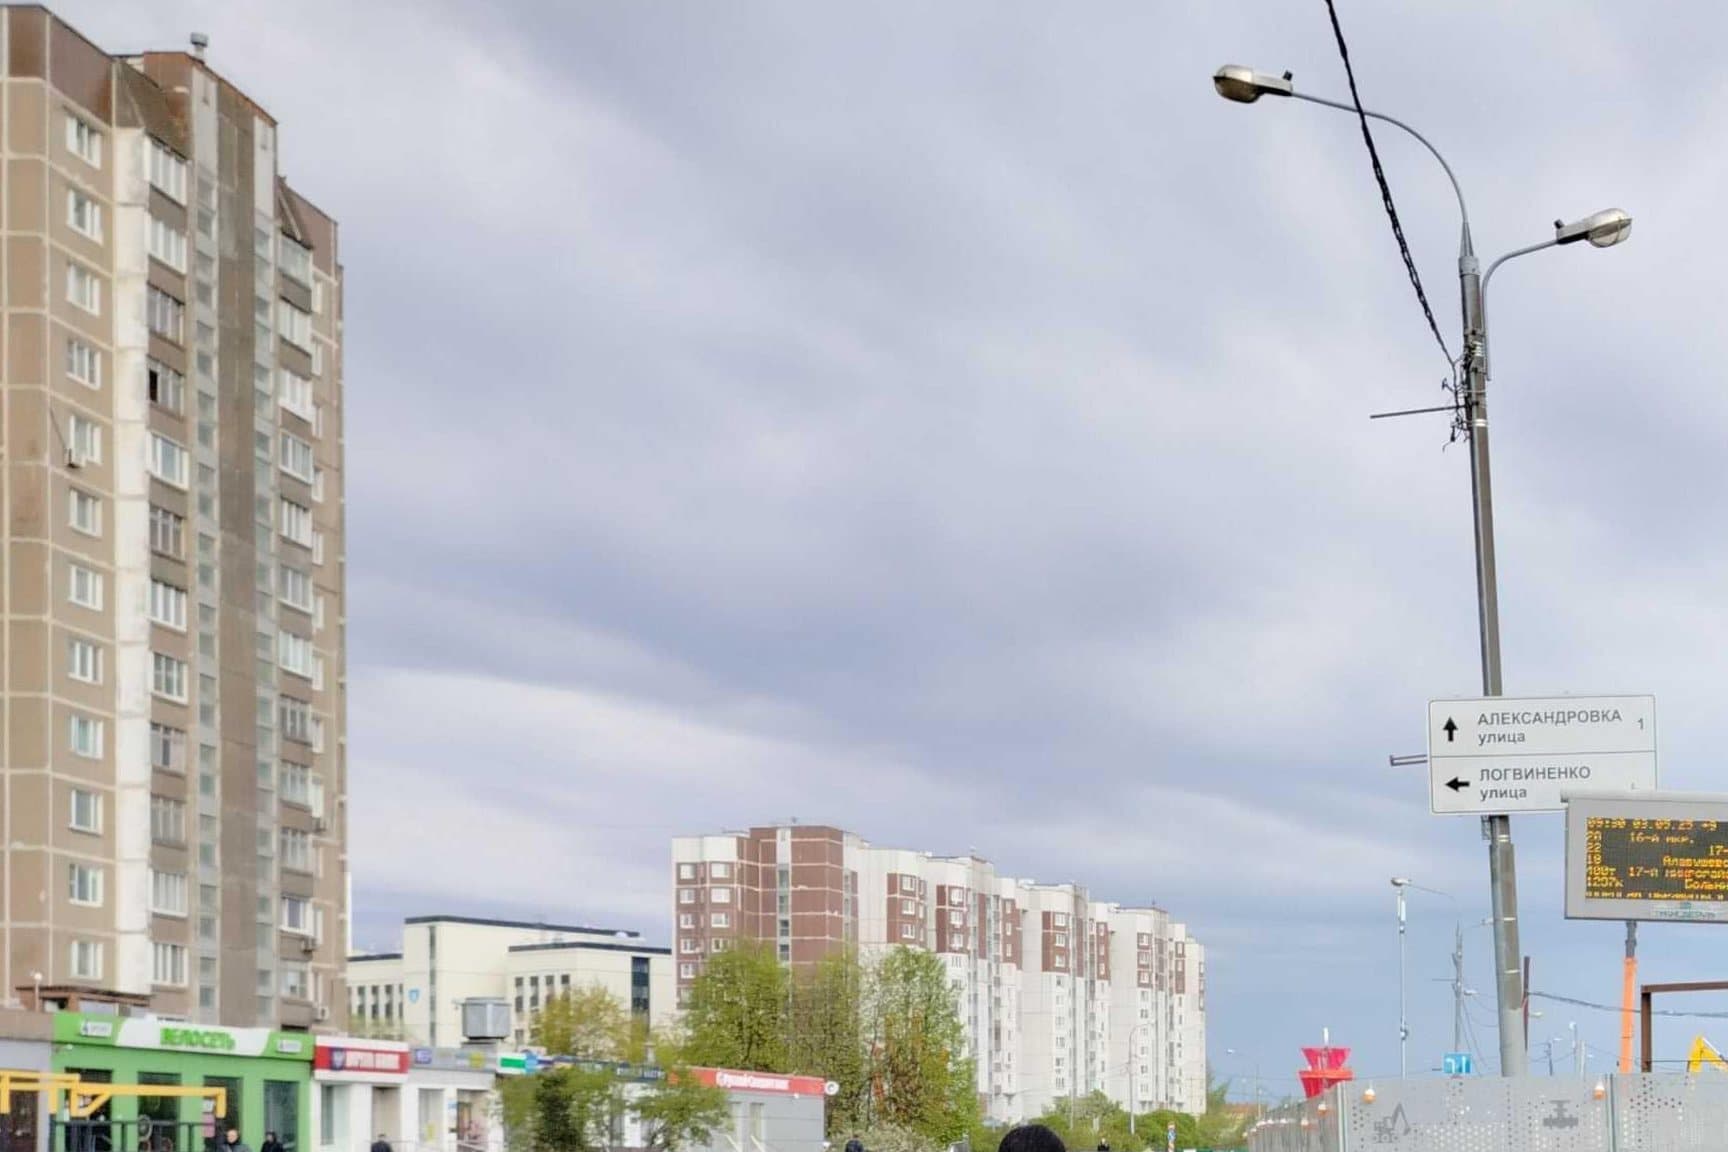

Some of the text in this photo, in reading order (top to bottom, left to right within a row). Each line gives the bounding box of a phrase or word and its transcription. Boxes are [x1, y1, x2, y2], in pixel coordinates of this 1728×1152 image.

[1478, 710, 1622, 726] АЛЕКСАНДРОВКА
[1637, 718, 1645, 730] 1
[1478, 732, 1526, 746] улица
[1480, 766, 1591, 782] ЛОГВИНЕНКО
[1480, 788, 1527, 801] улица
